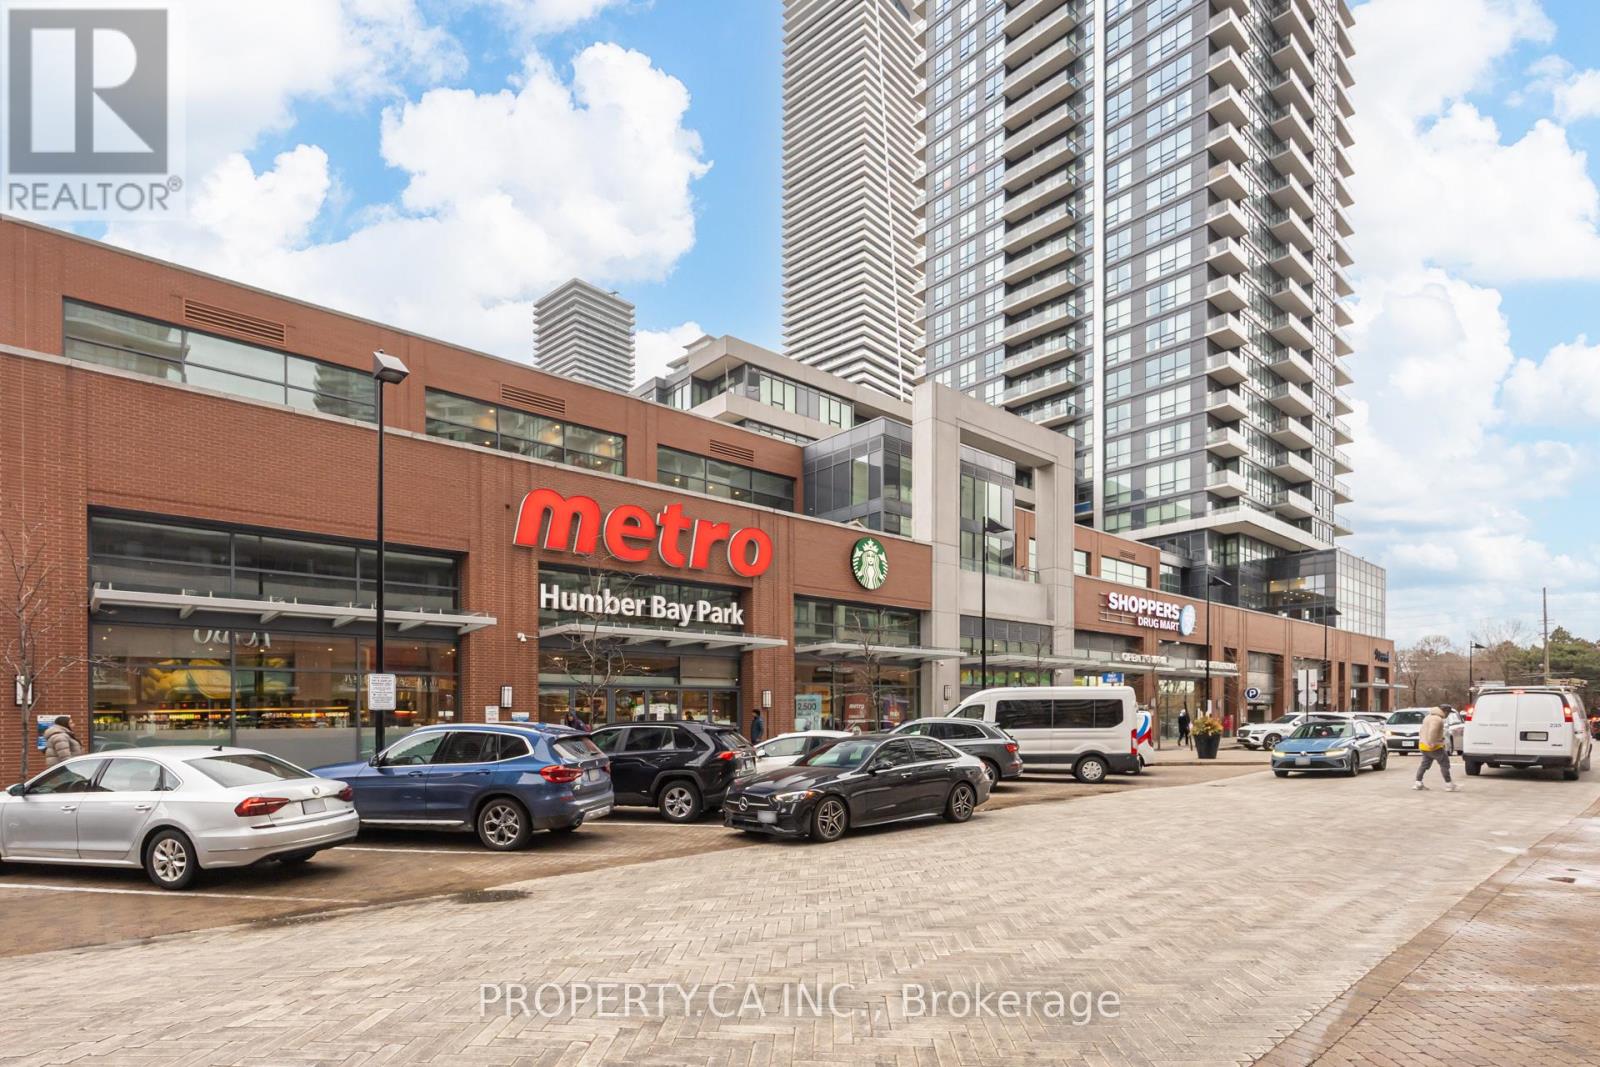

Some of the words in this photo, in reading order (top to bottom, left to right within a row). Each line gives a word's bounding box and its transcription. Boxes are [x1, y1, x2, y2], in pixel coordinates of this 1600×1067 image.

[512, 487, 773, 577] metro
[540, 583, 646, 617] Humber
[651, 595, 693, 627] Bay
[697, 600, 744, 625] Park
[1107, 591, 1180, 620] SHOPPERS
[1137, 616, 1159, 629] DRUG
[1160, 620, 1180, 631] MART
